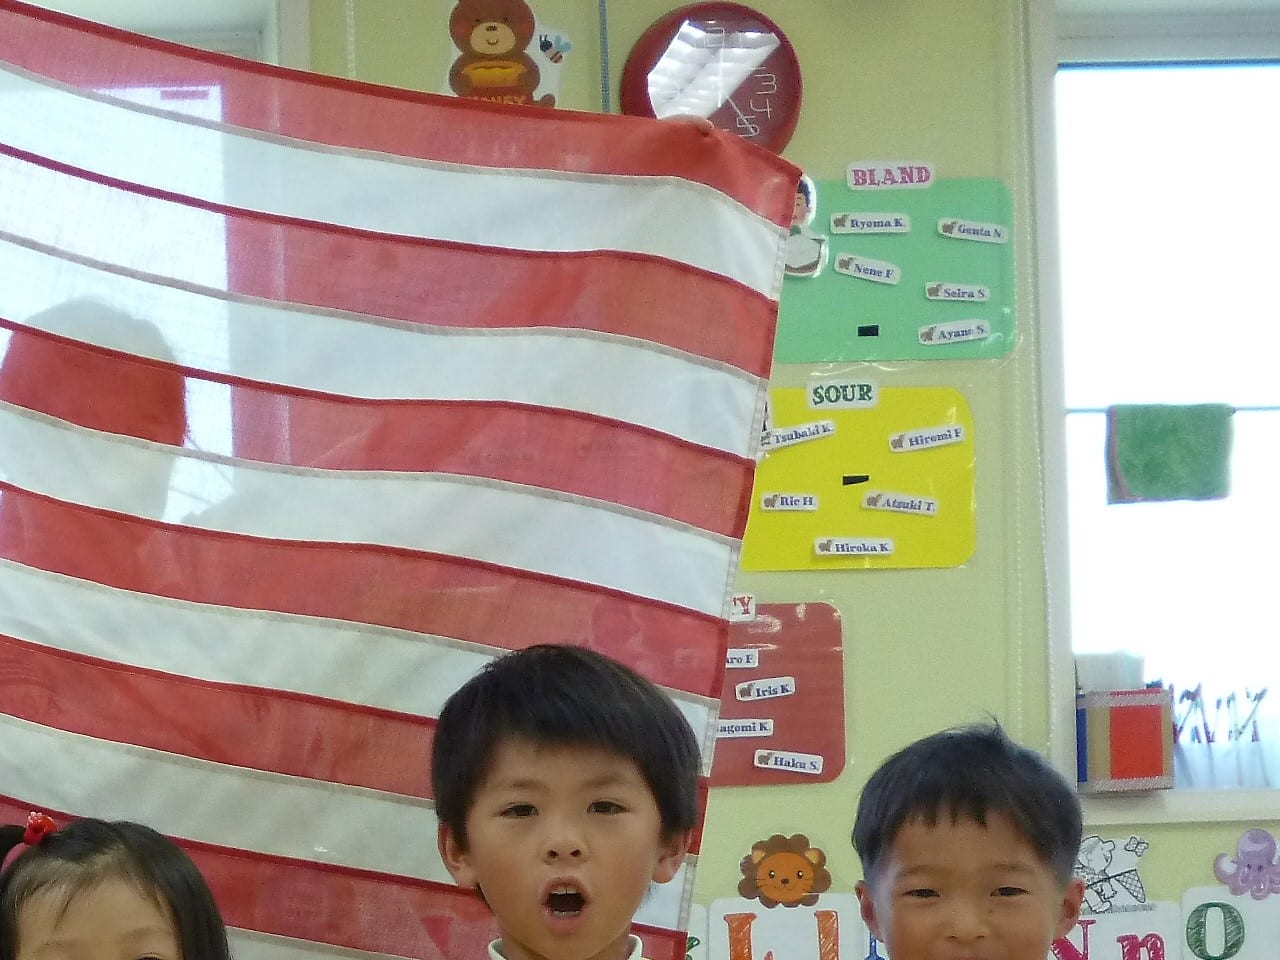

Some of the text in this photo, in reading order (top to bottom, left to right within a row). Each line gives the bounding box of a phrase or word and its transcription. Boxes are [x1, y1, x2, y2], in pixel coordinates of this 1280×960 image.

[749, 98, 773, 119] 4
[852, 165, 931, 186] BLAND
[850, 217, 891, 229] Ryoma
[958, 224, 990, 237] Genta
[854, 264, 882, 276] Nene
[943, 288, 975, 298] Seira
[938, 328, 972, 340] Ayane
[812, 384, 873, 405] SOUR
[773, 424, 820, 444] Tsubaki
[909, 430, 952, 447] Hiromi
[882, 500, 922, 511] Atsuki
[835, 543, 878, 552] Hiroka
[755, 685, 778, 697] Iris
[717, 721, 756, 734] agomi
[773, 756, 806, 769] Haku
